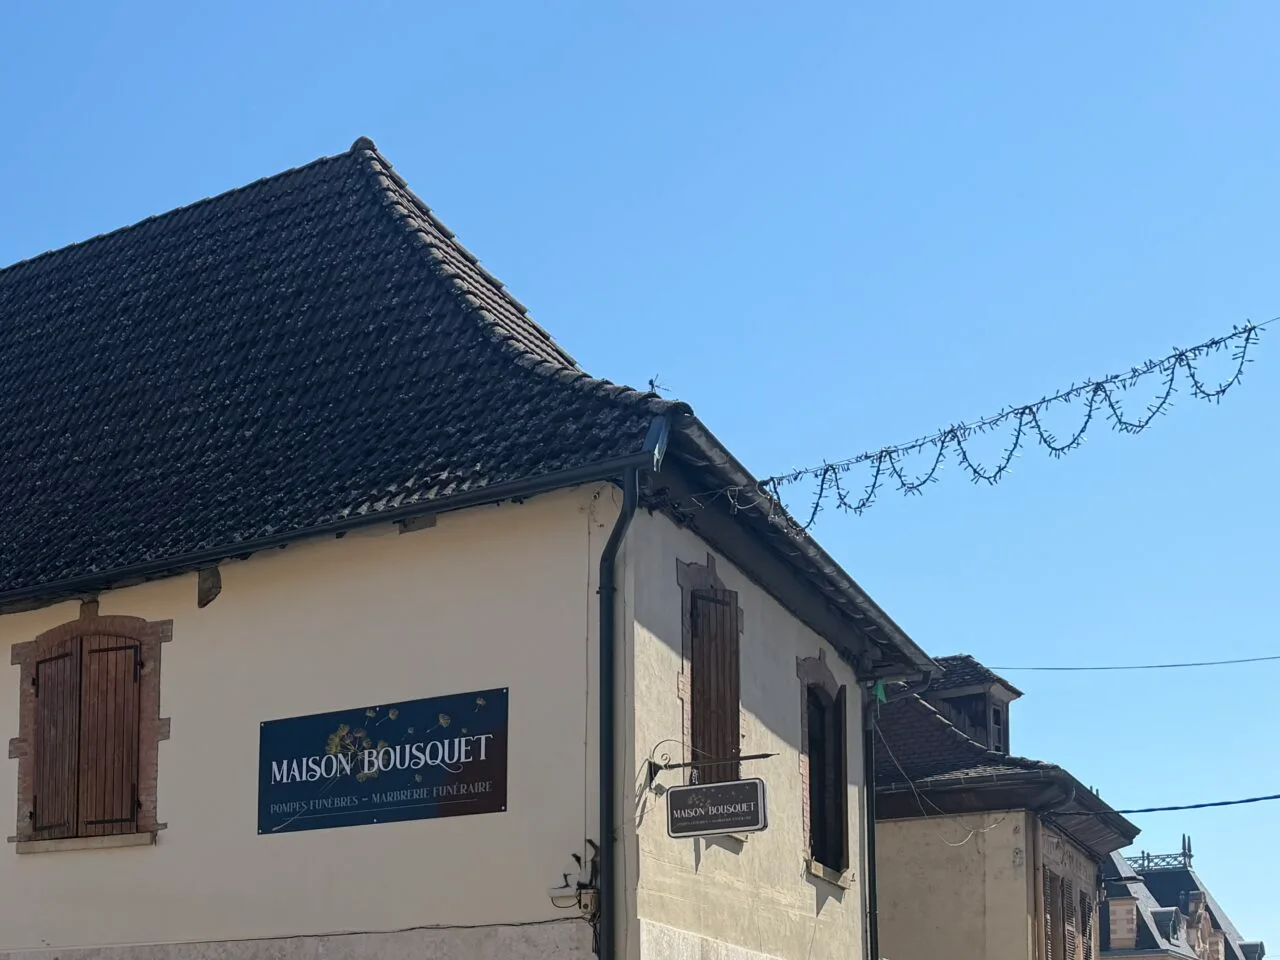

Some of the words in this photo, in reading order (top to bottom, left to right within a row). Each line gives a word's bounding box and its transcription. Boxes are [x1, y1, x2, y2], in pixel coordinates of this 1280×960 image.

[271, 752, 351, 784] MAISON
[363, 734, 494, 774] BOUSQUET
[270, 800, 309, 815] POMPES
[310, 794, 359, 811] FUNÈBRES
[371, 787, 430, 805] MARBRERIE
[433, 780, 493, 799] FUNÉRAIRE
[673, 807, 705, 819] MAISON
[708, 802, 756, 816] BOUSQUET
